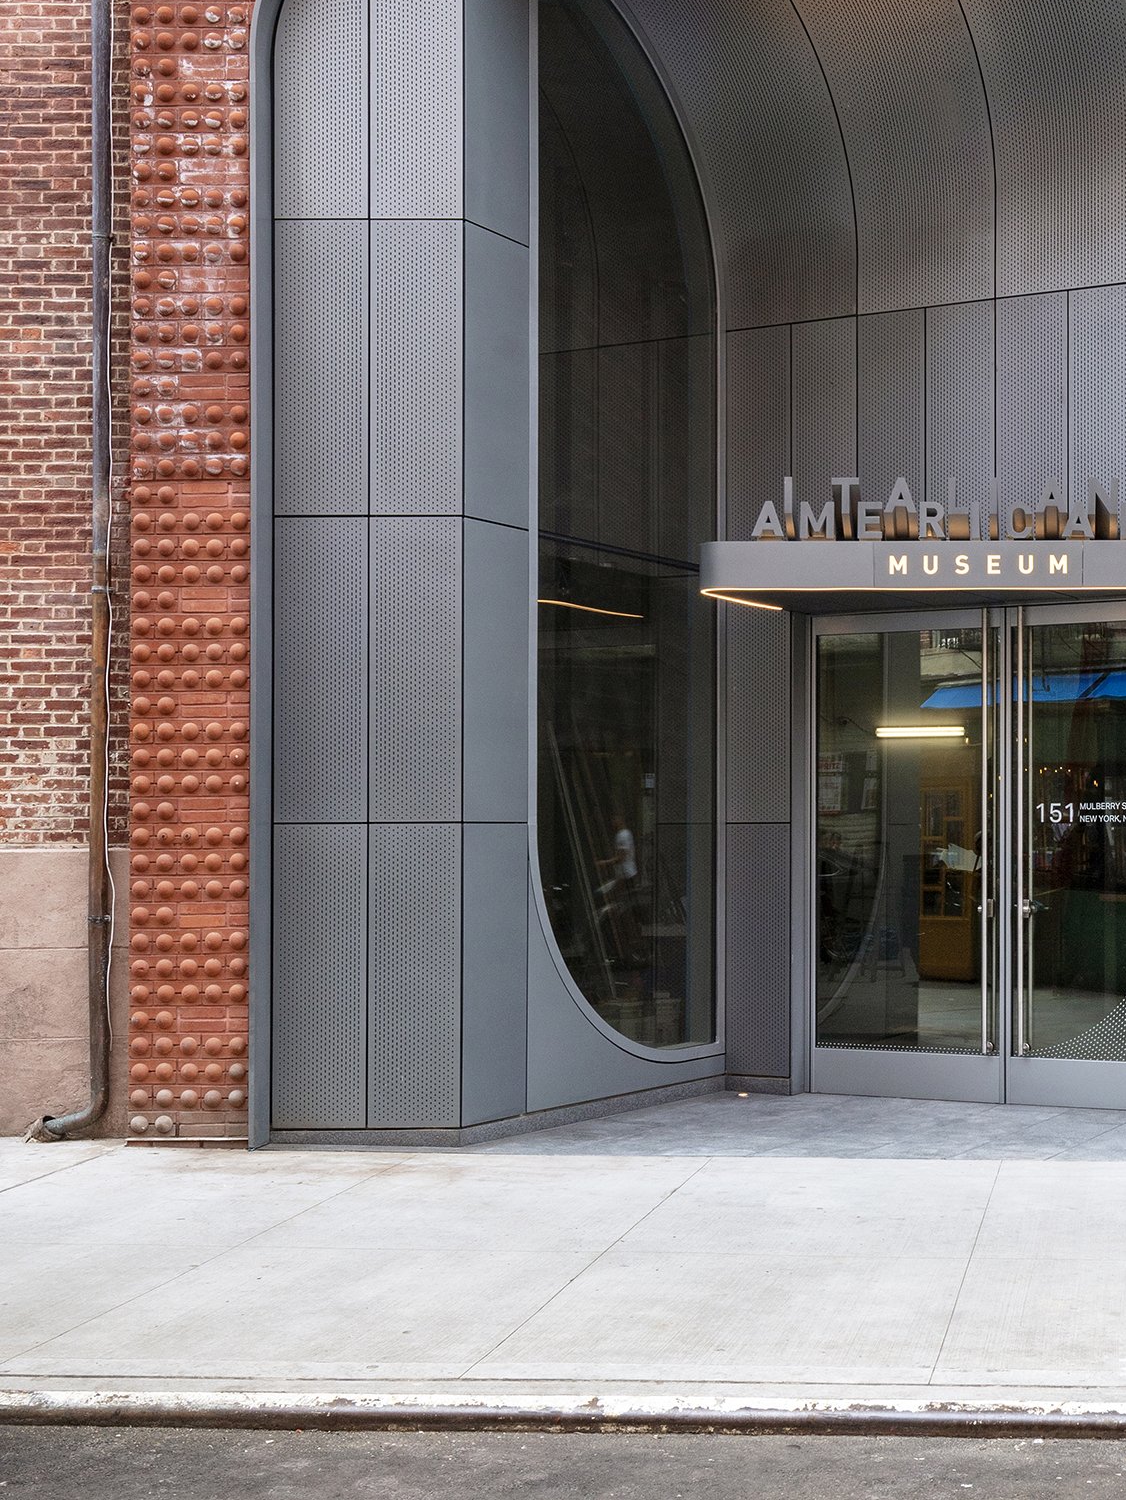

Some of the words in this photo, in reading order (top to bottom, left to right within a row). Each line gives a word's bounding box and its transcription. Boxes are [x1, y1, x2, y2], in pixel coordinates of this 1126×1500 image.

[784, 476, 1119, 515] ITALIAN
[888, 554, 1069, 576] MUSEUM
[1036, 802, 1075, 823] 151
[1079, 802, 1120, 810] MULBERRY
[1079, 815, 1097, 823] NEW
[1099, 815, 1121, 823] YORK,
